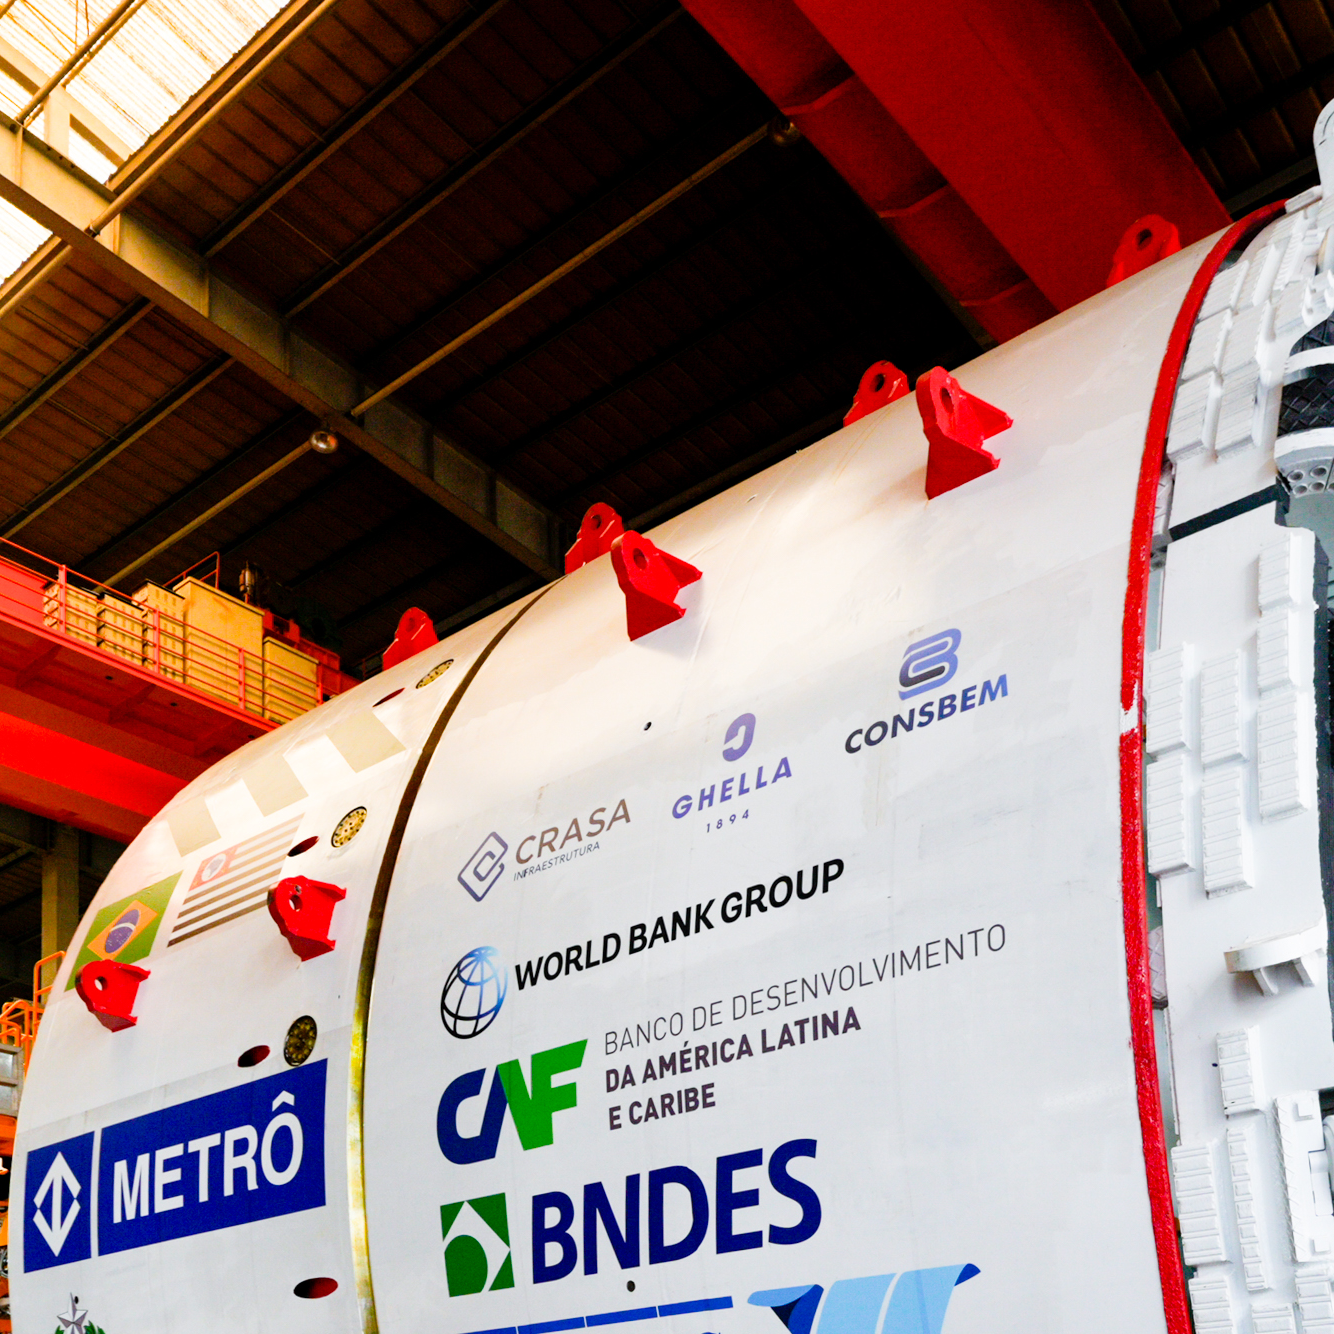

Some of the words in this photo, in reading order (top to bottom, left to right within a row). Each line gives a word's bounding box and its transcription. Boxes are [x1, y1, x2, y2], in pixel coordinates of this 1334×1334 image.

[844, 674, 1008, 753] CONSBEM
[671, 756, 792, 819] GHELLA
[705, 809, 750, 833] 1894
[513, 841, 600, 881] INFRAESTRUTURA
[516, 798, 631, 864] CRASA
[515, 932, 621, 990] WORLD
[628, 900, 717, 954] BANK
[720, 858, 845, 923] GROUP
[604, 1012, 684, 1055] BANCO
[693, 1003, 724, 1032] DE
[732, 923, 1006, 1022] DESENVOLVIMENTO
[605, 1061, 637, 1093] DA
[642, 1036, 754, 1084] AMÉRICA
[761, 1005, 861, 1053] LATINA
[609, 1106, 623, 1130] E
[628, 1082, 716, 1126] CARIBE
[113, 1090, 304, 1224] METRÔ
[531, 1137, 822, 1284] BNDES
